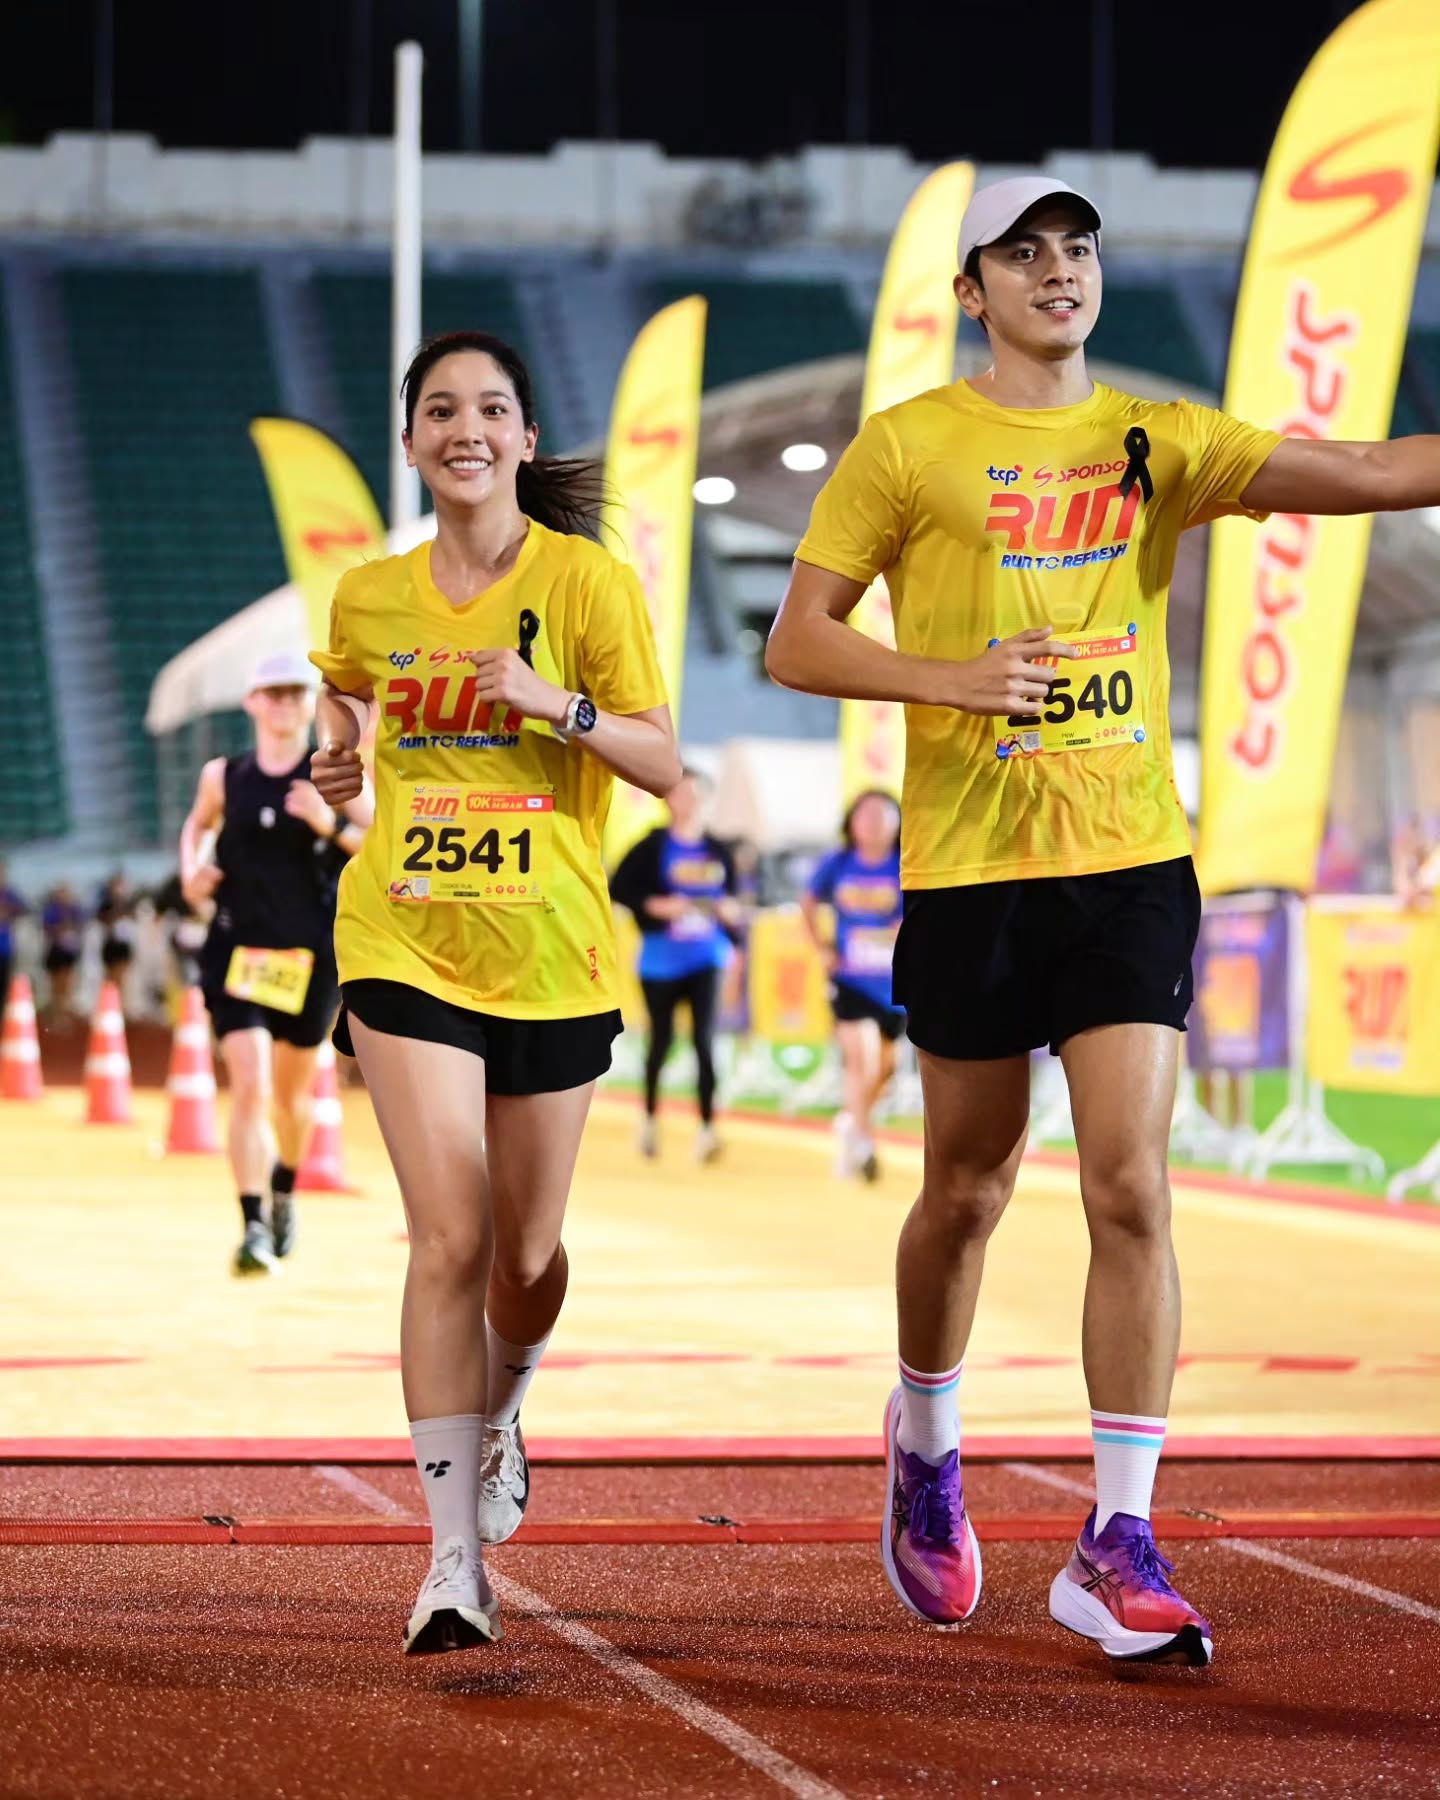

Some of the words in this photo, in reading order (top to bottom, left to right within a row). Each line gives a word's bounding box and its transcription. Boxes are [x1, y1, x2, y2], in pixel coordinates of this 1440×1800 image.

[986, 464, 1023, 486] tcp
[1056, 459, 1131, 483] SPONSO
[985, 483, 1140, 553] RUN
[1001, 554, 1033, 569] RUN
[1035, 556, 1059, 569] TO
[1062, 543, 1128, 569] REFRESH
[388, 648, 421, 671] tcp
[398, 735, 427, 749] RUN
[410, 796, 460, 817] RUN
[468, 796, 491, 810] 10K
[403, 826, 530, 874] 2541
